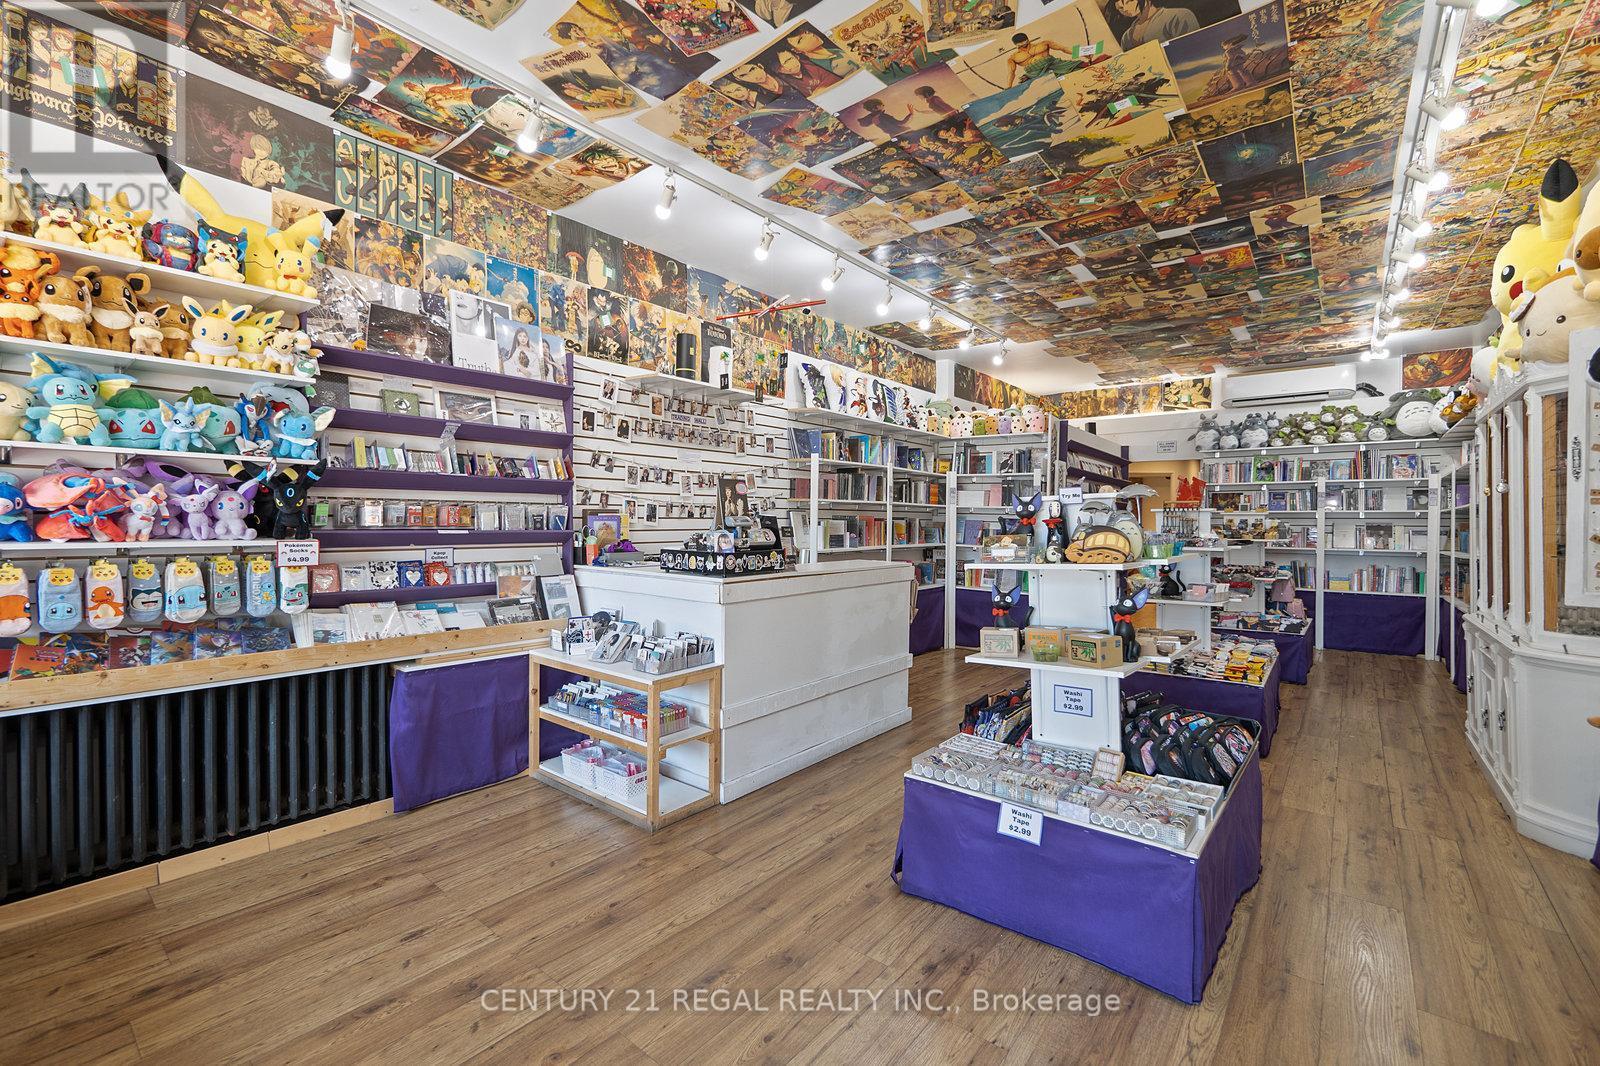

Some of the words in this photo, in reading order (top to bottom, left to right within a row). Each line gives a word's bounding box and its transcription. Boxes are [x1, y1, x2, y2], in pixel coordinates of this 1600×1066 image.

[1063, 703, 1084, 711] $2.99
[1011, 808, 1032, 819] Washi
[1012, 816, 1030, 827] Tape
[1009, 824, 1032, 837] $2.99
